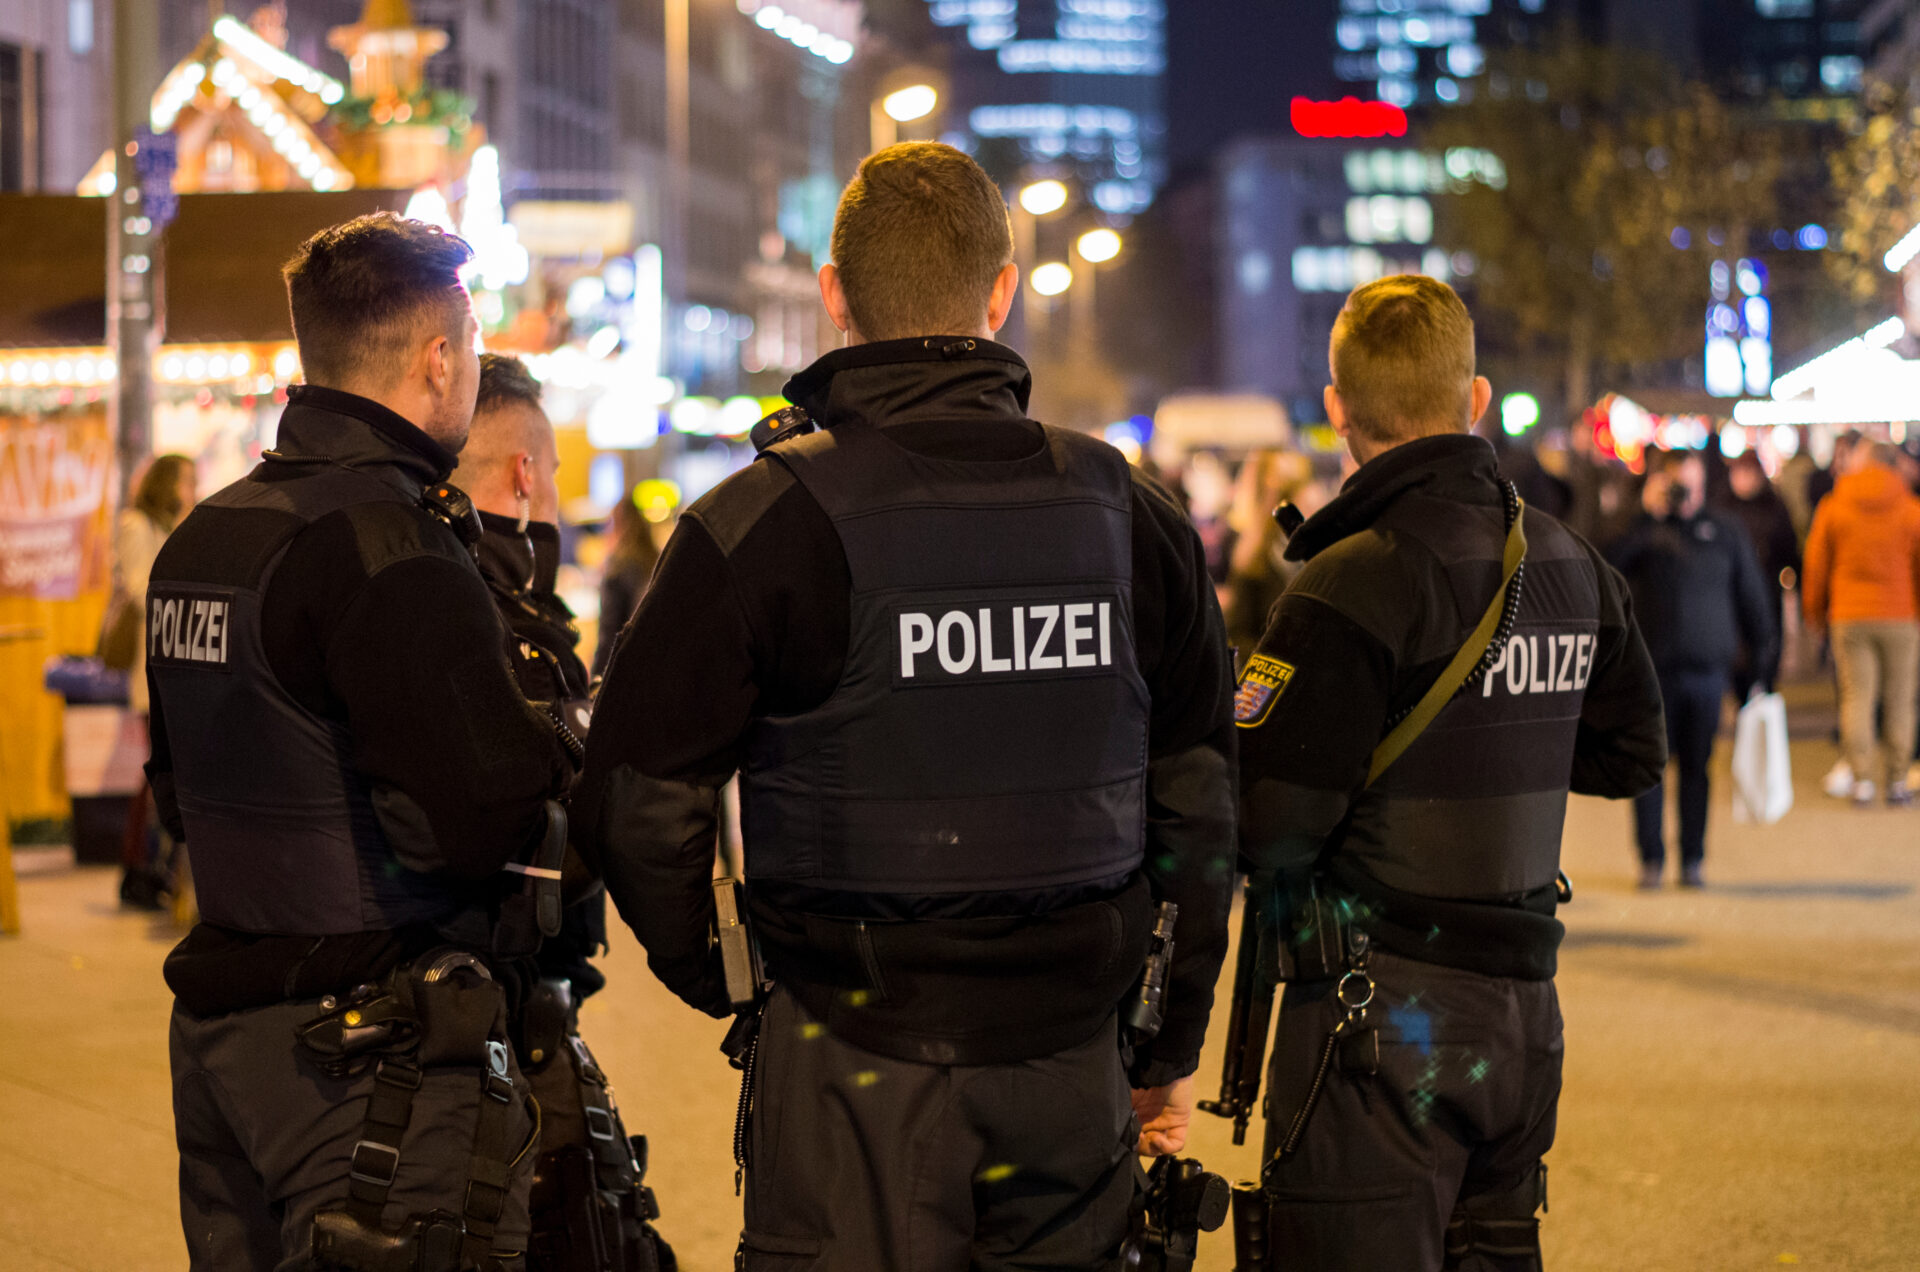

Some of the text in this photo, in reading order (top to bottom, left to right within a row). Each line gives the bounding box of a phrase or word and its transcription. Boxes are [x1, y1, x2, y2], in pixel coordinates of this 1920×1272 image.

[151, 598, 229, 663] POLIZEI
[900, 602, 1112, 678] POLIZEI
[1249, 659, 1291, 681] POLIZEI
